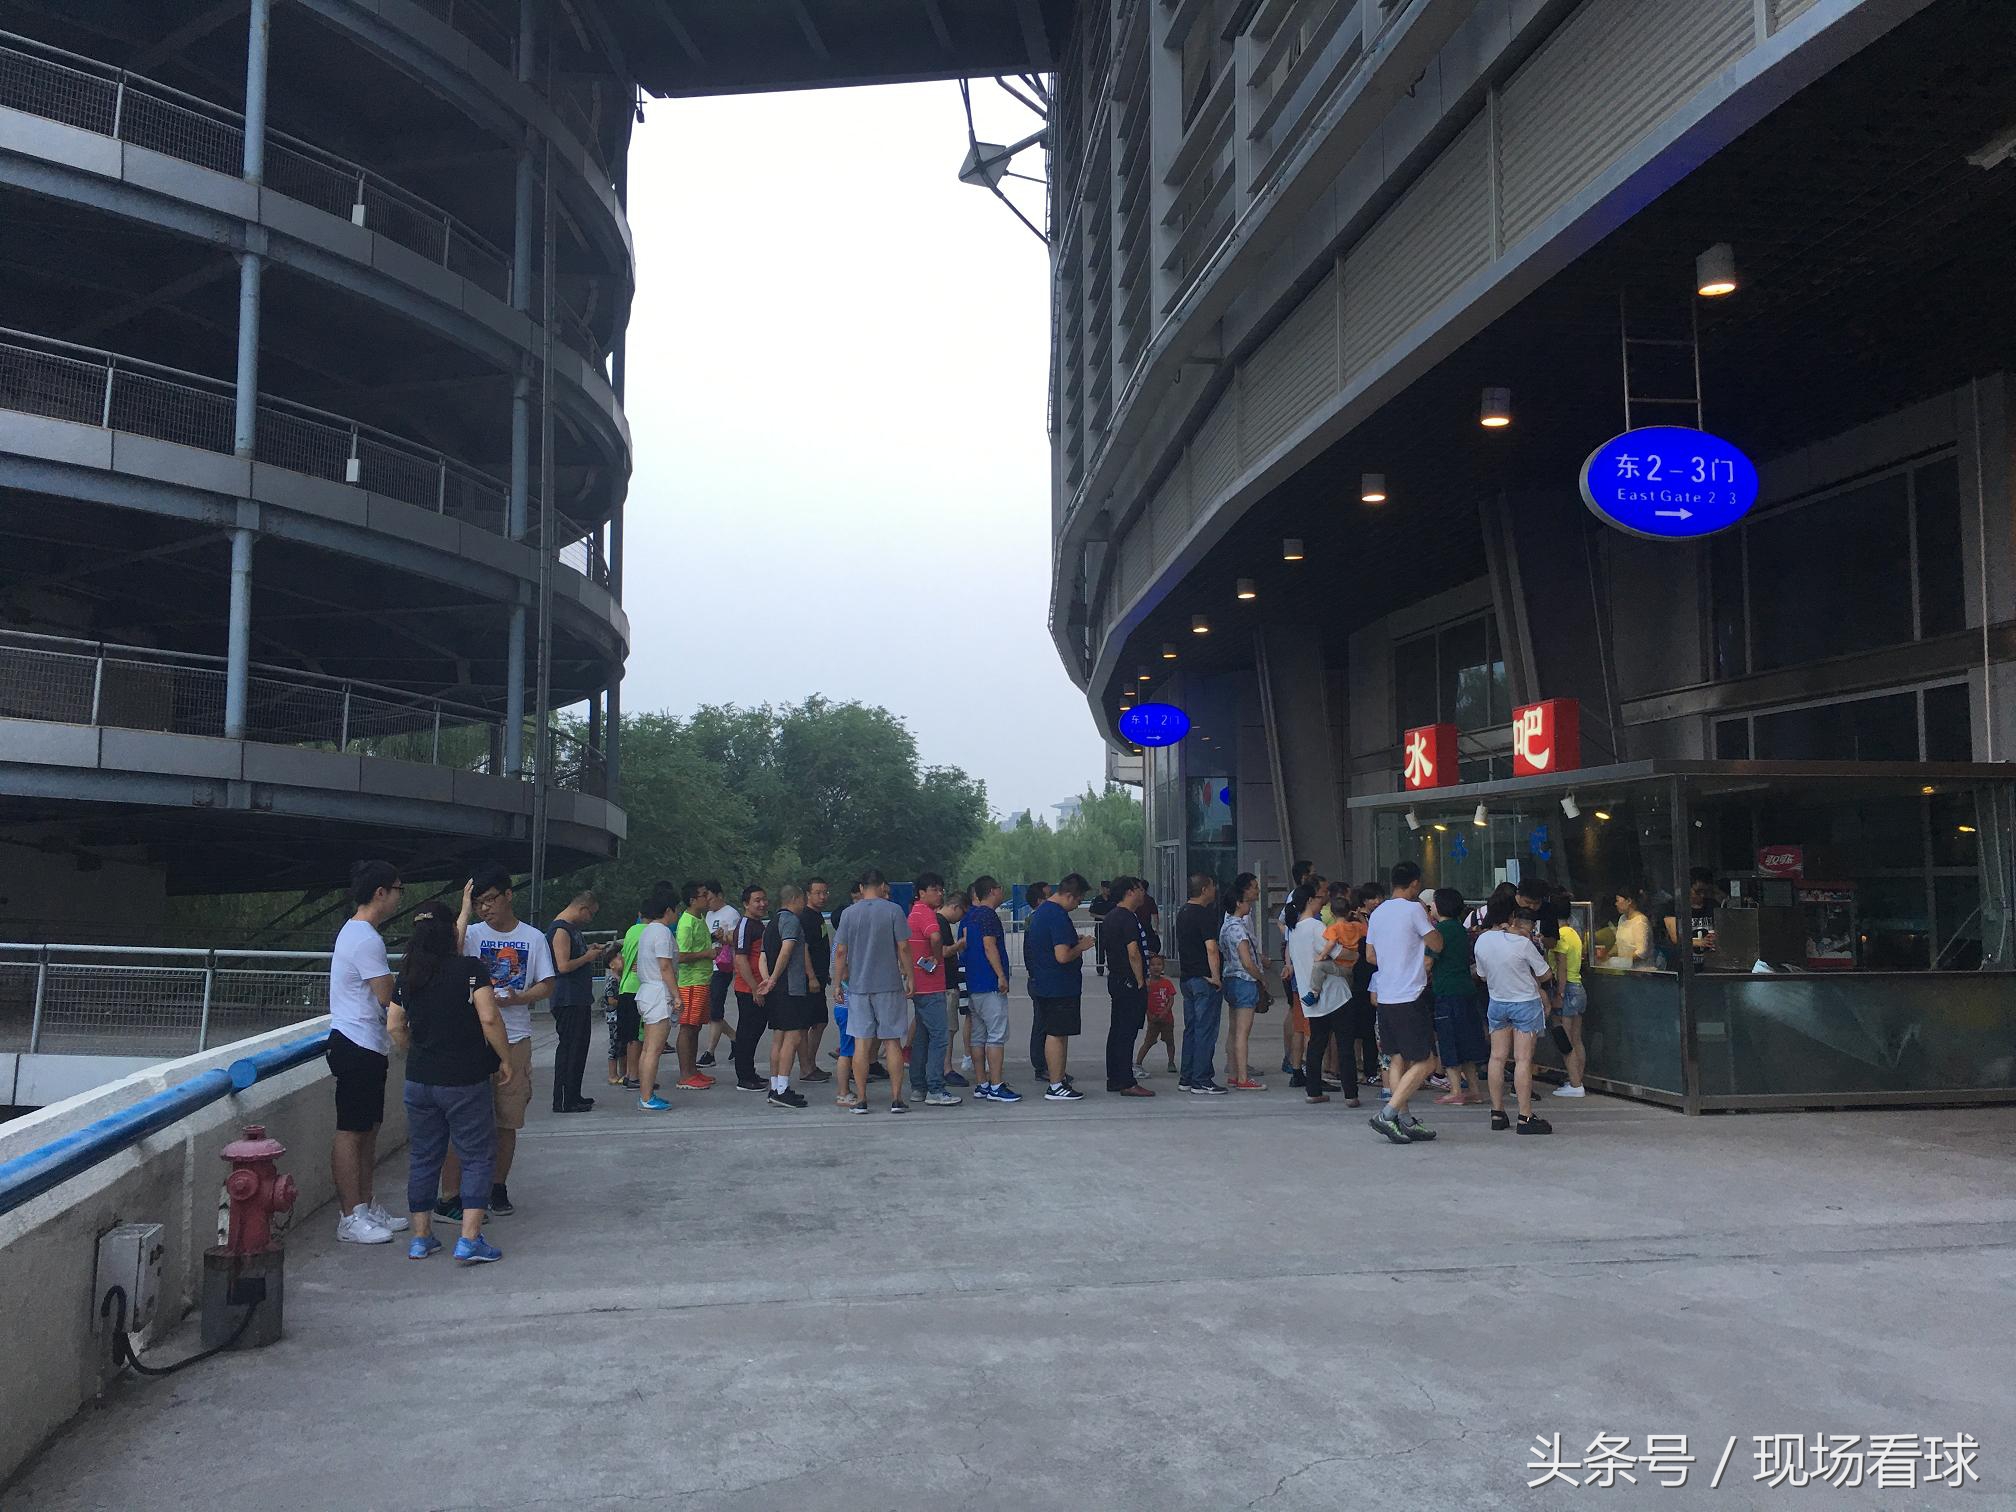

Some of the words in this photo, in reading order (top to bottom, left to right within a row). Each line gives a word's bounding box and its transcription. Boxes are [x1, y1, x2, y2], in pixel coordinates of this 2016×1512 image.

[1660, 489, 1702, 503] Gate
[1404, 731, 1433, 787] 水
[1513, 706, 1549, 770] 吧
[481, 940, 496, 948] AIR
[498, 941, 526, 949] FORCE
